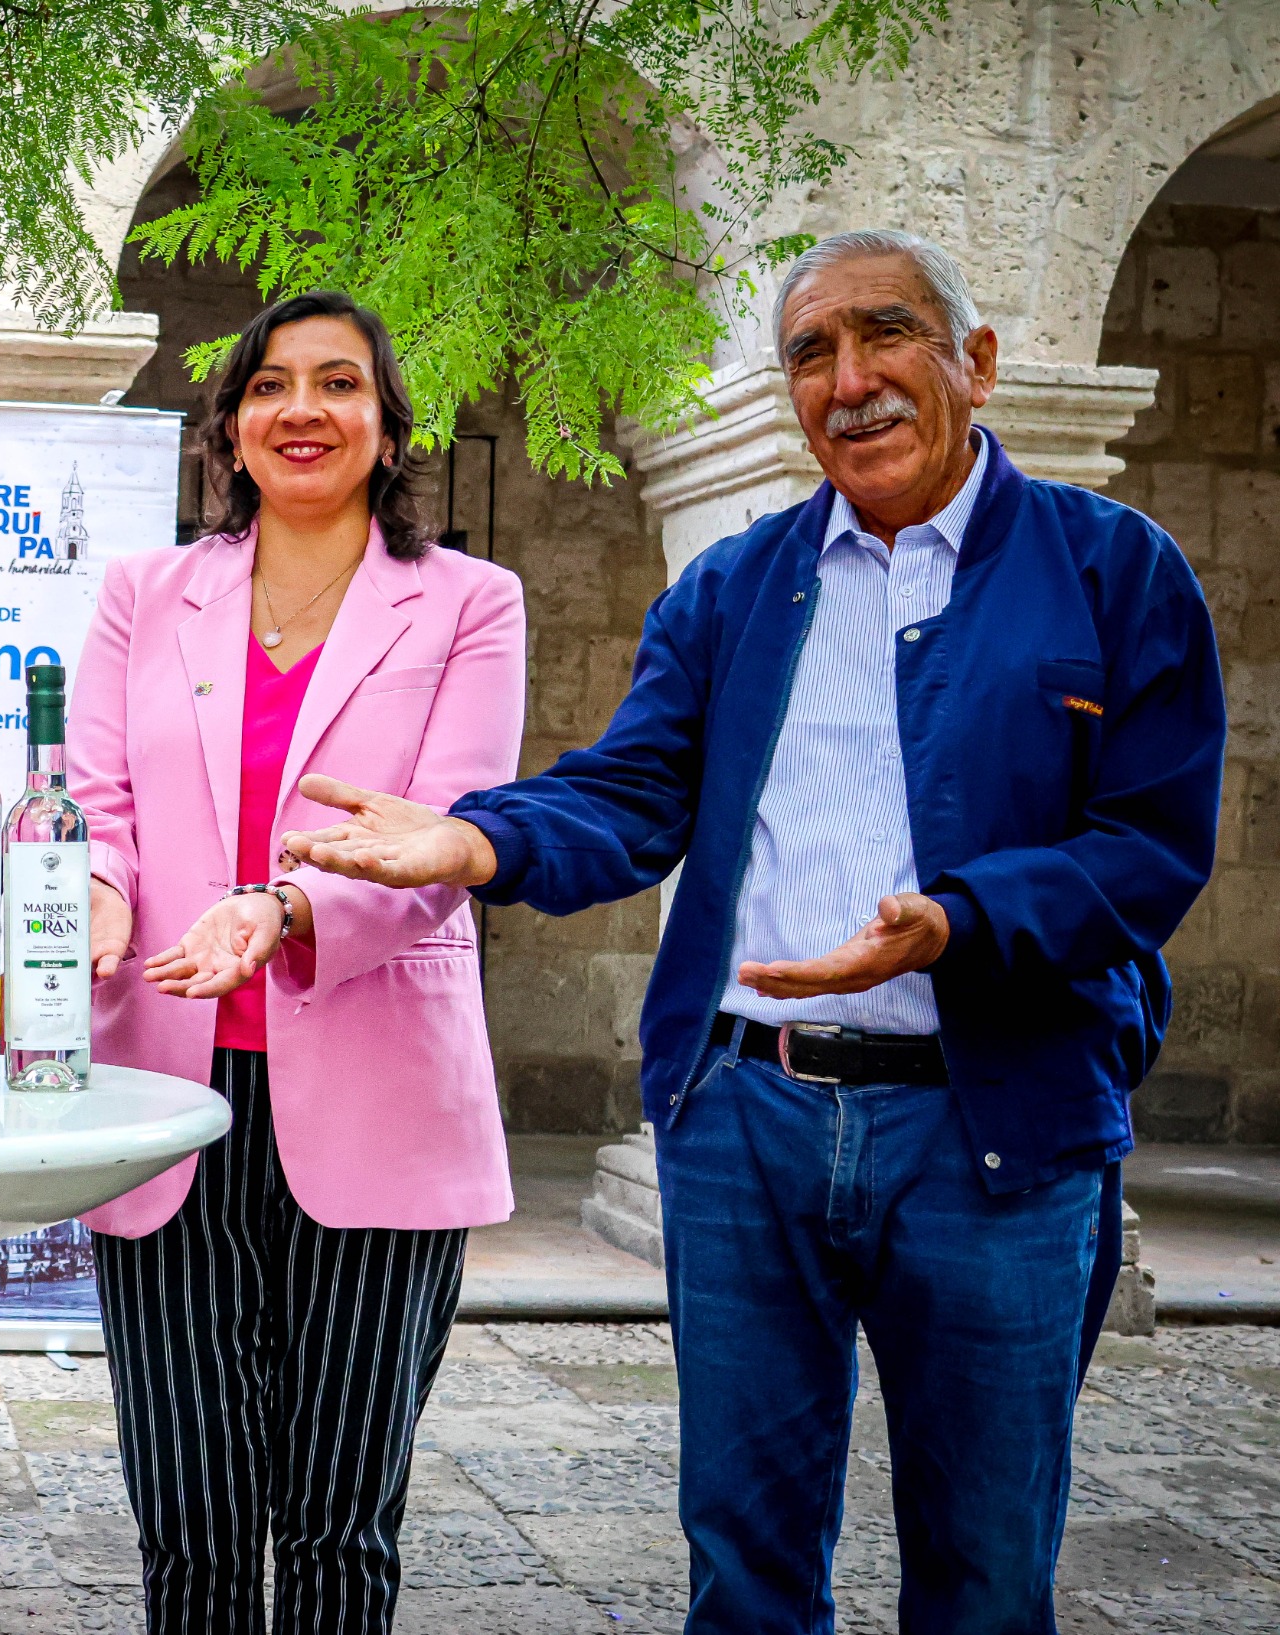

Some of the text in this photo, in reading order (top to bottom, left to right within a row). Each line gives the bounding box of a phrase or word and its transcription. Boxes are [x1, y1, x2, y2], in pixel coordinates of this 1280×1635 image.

[18, 536, 55, 559] PA
[8, 558, 73, 576] humanidad
[23, 902, 79, 917] MARQUES
[43, 912, 56, 920] DE
